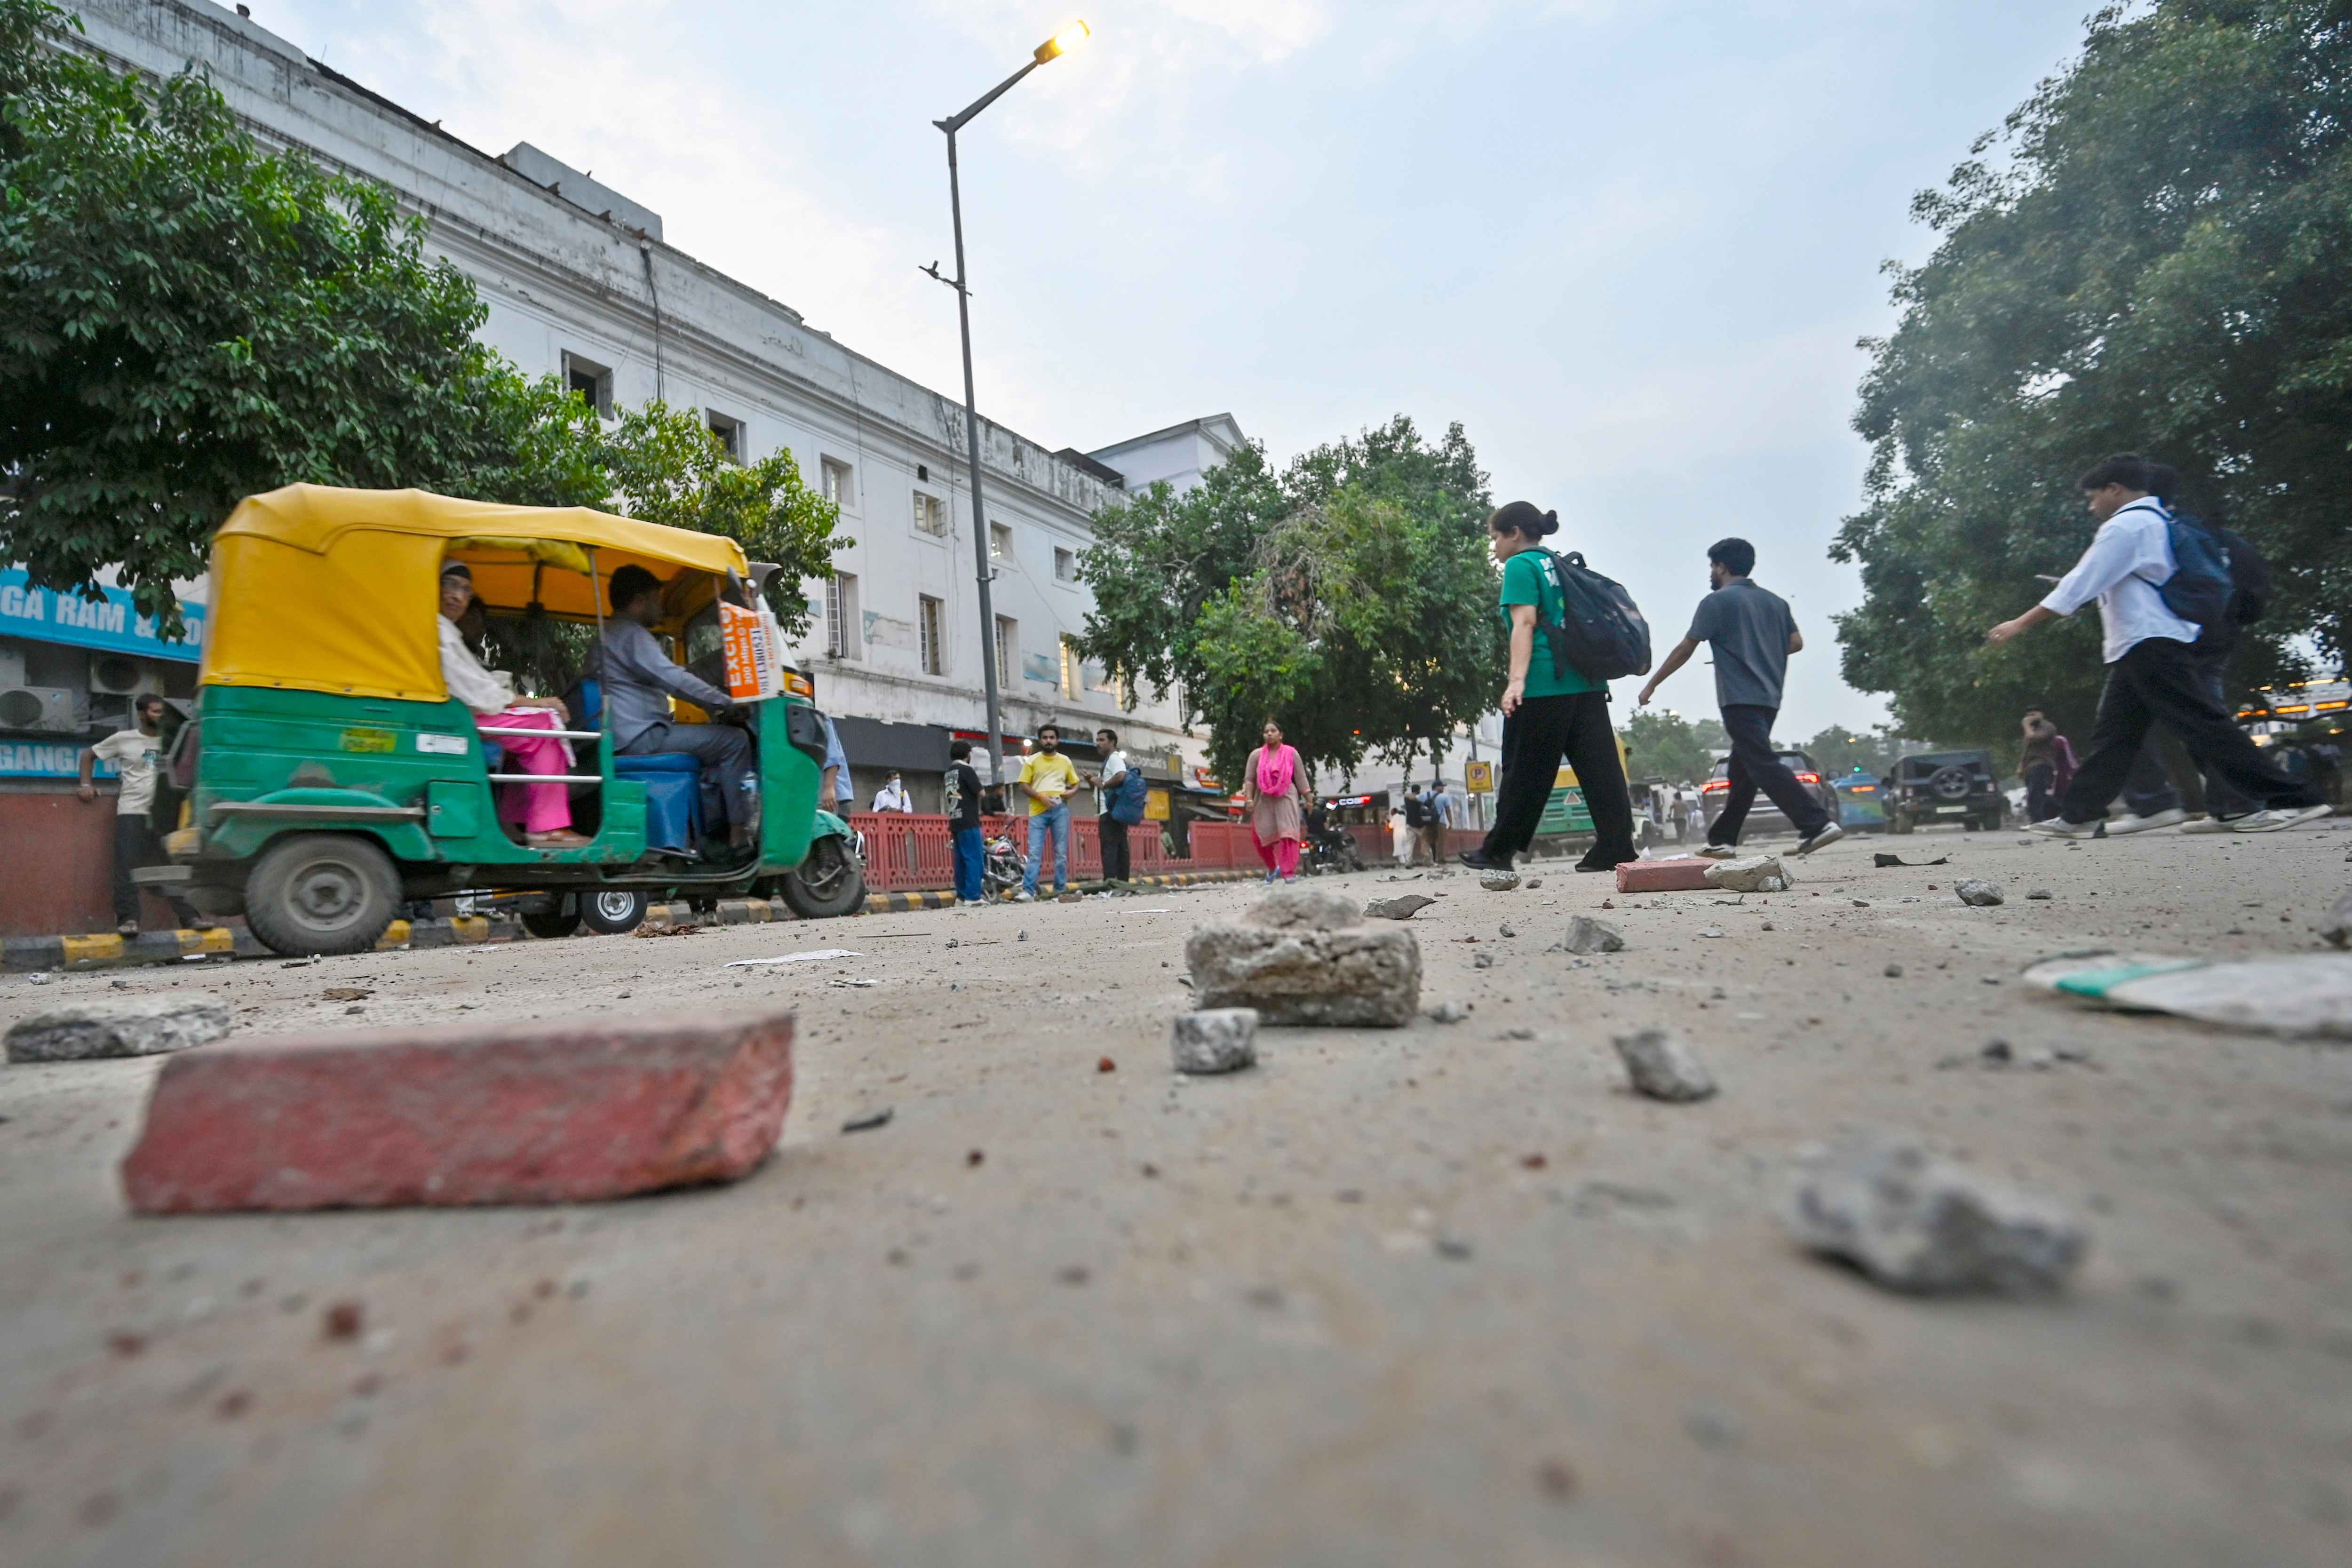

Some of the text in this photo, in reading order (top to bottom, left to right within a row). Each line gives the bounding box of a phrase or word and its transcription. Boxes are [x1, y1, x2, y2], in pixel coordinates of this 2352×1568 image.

[0, 585, 45, 621] GA
[55, 595, 126, 634] RAM
[1127, 754, 1167, 770] cDonald's
